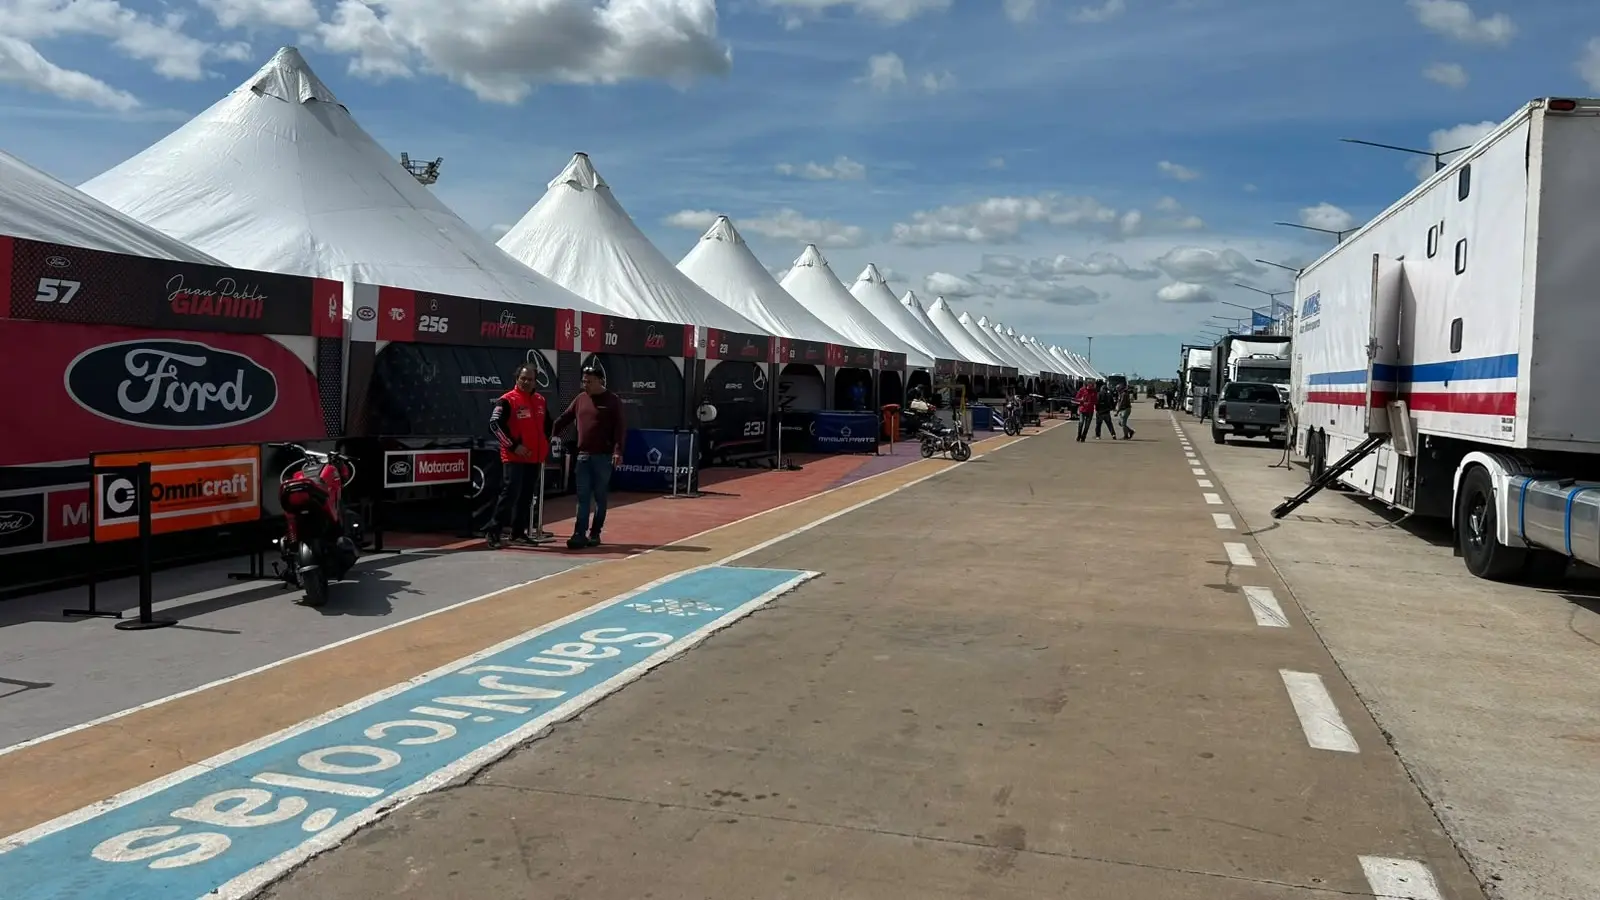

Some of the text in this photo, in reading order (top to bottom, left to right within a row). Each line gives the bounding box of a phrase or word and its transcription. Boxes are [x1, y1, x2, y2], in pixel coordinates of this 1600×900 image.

[35, 277, 81, 304] 57
[166, 273, 269, 304] Juan Pablo
[172, 292, 265, 319] GIANINI
[418, 314, 449, 333] 256
[605, 332, 618, 346] 110
[117, 348, 252, 414] Ford
[473, 375, 502, 385] AMG
[743, 421, 765, 436] 231
[418, 458, 465, 474] Motorcraft
[150, 473, 248, 502] Omnicraft
[91, 627, 675, 869] San Nicolás
